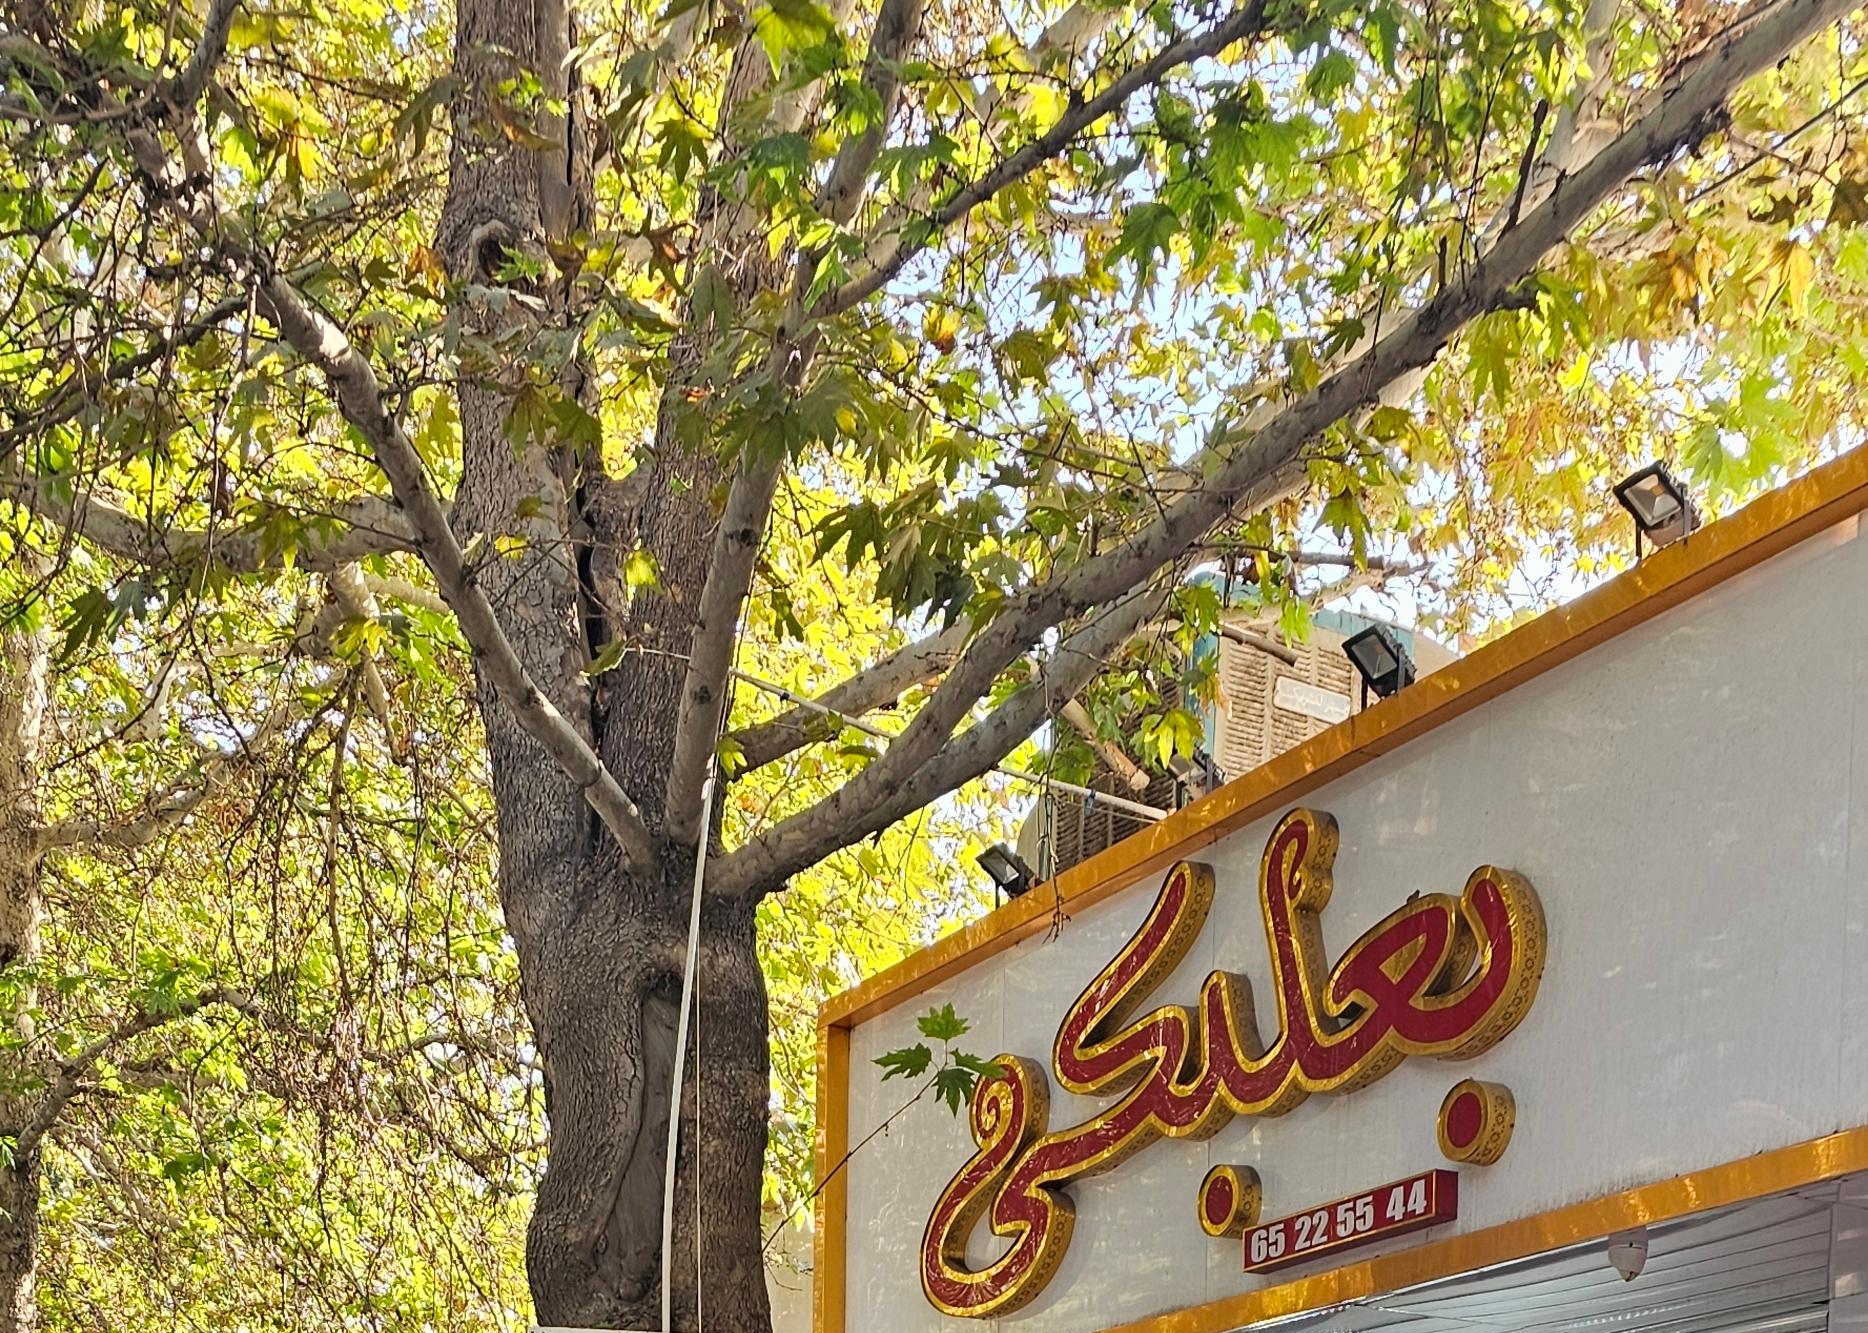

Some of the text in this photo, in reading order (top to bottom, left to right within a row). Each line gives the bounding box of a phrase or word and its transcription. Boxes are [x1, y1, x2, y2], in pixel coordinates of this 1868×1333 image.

[921, 808, 1546, 1318] بعلبکی
[1250, 1179, 1427, 1263] 65 22 55 44
